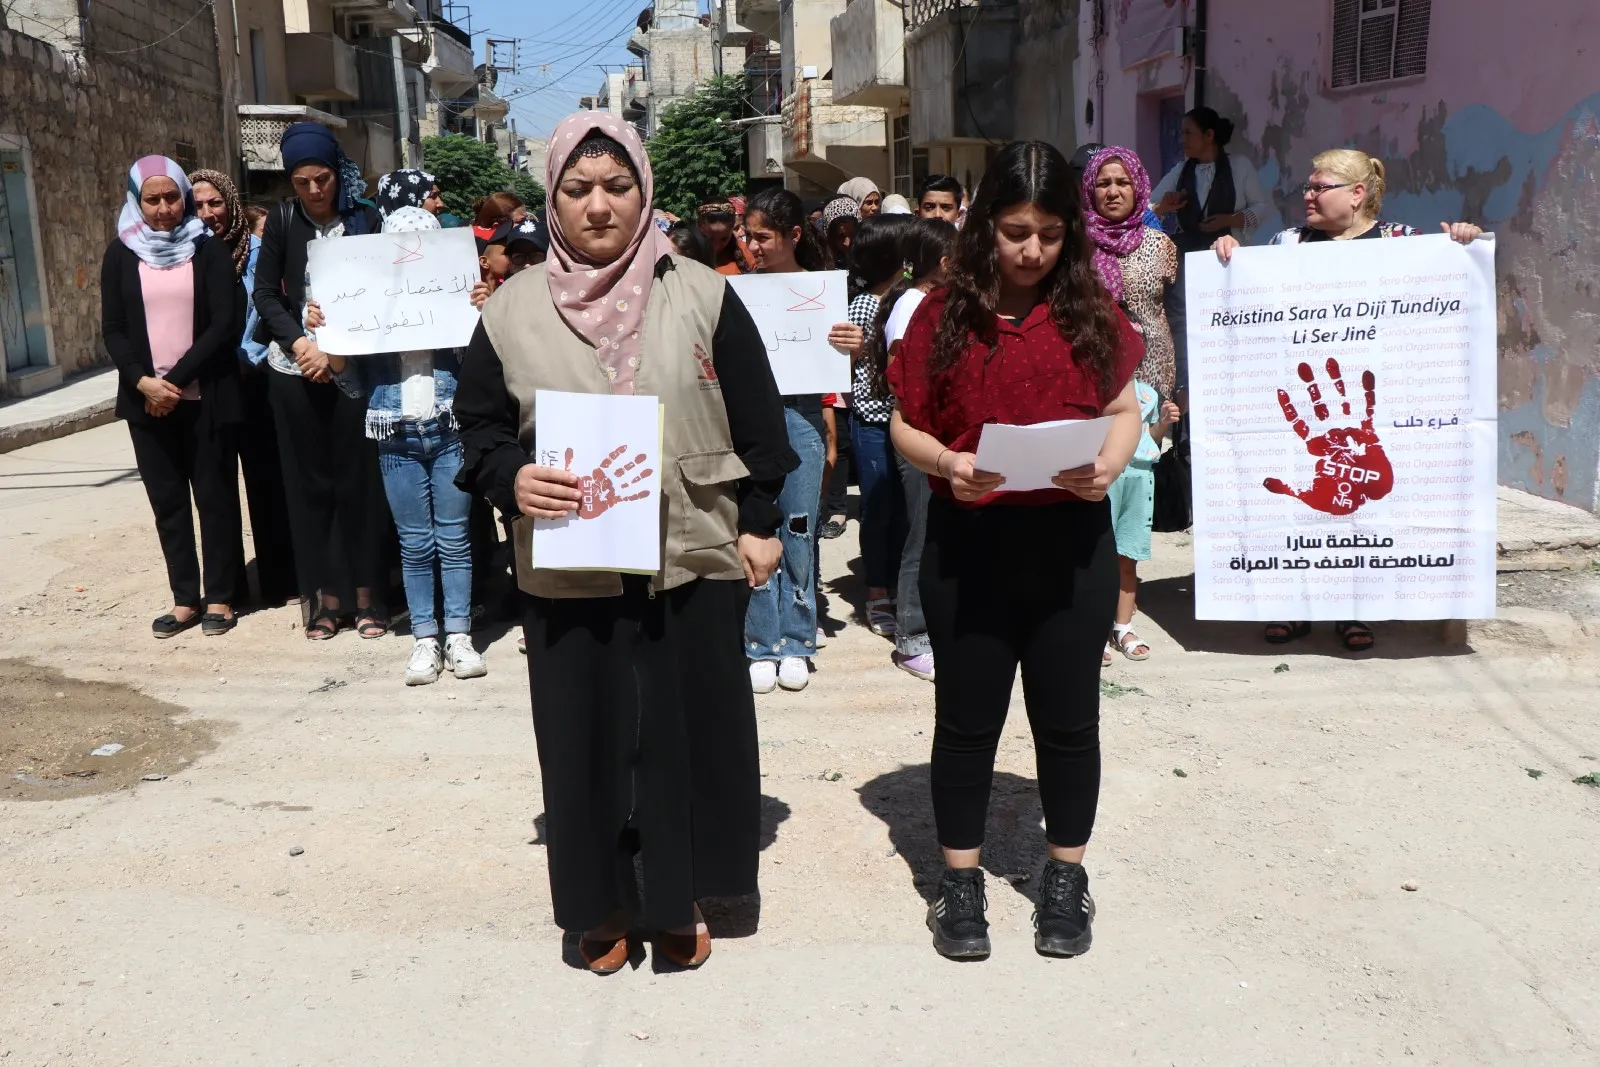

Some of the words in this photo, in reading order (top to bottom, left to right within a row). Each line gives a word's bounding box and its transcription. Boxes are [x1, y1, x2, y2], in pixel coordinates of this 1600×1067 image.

[393, 236, 424, 264] لا
[786, 279, 826, 312] لا
[1211, 309, 1284, 327] Rêxistina
[1288, 305, 1325, 321] Sara
[1332, 303, 1352, 319] Ya
[1357, 301, 1387, 320] Dijî
[1391, 297, 1462, 316] Tundiya
[1293, 329, 1307, 344] Li
[1310, 328, 1338, 343] Ser
[1341, 325, 1376, 341] Jinê
[1322, 459, 1380, 484] STOP
[583, 480, 593, 512] STOP
[1286, 535, 1322, 551] سارا
[1326, 534, 1394, 549] منظمة
[1230, 553, 1278, 573] المرأة
[1281, 556, 1311, 570] ضد
[1313, 556, 1364, 569] العنف
[1369, 554, 1455, 569] لمناهضة
